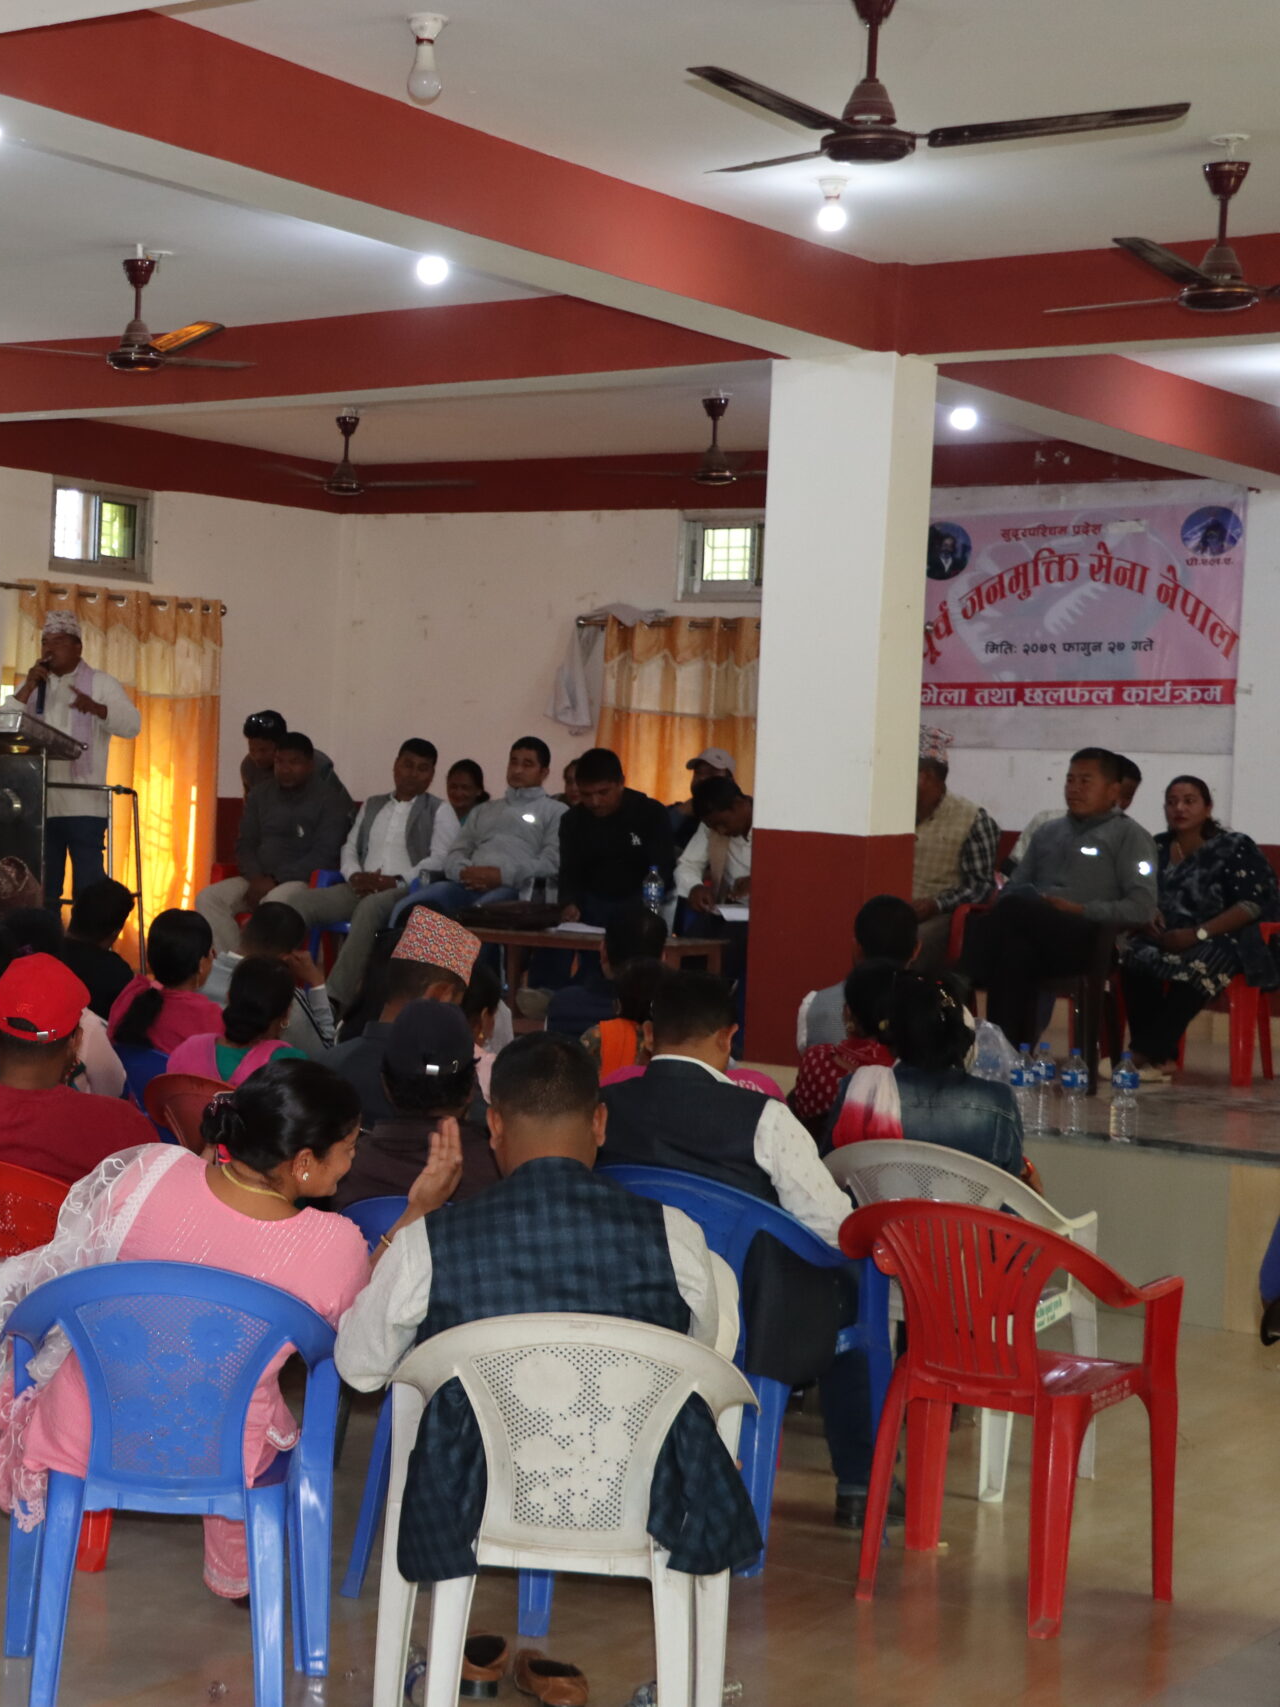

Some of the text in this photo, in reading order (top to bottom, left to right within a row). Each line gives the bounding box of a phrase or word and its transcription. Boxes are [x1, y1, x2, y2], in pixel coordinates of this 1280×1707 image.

[1072, 522, 1102, 536] प्रदेश
[959, 547, 1080, 620] जनमुक्ति
[1089, 541, 1150, 594] सेना
[1157, 564, 1239, 660] नेपाल
[1062, 641, 1102, 656] फागुन
[1108, 641, 1125, 654] २७
[1132, 637, 1154, 652] गते
[975, 688, 1017, 705] तथा
[1024, 687, 1115, 705] छलफल
[1122, 681, 1223, 704] कार्यक्रम
